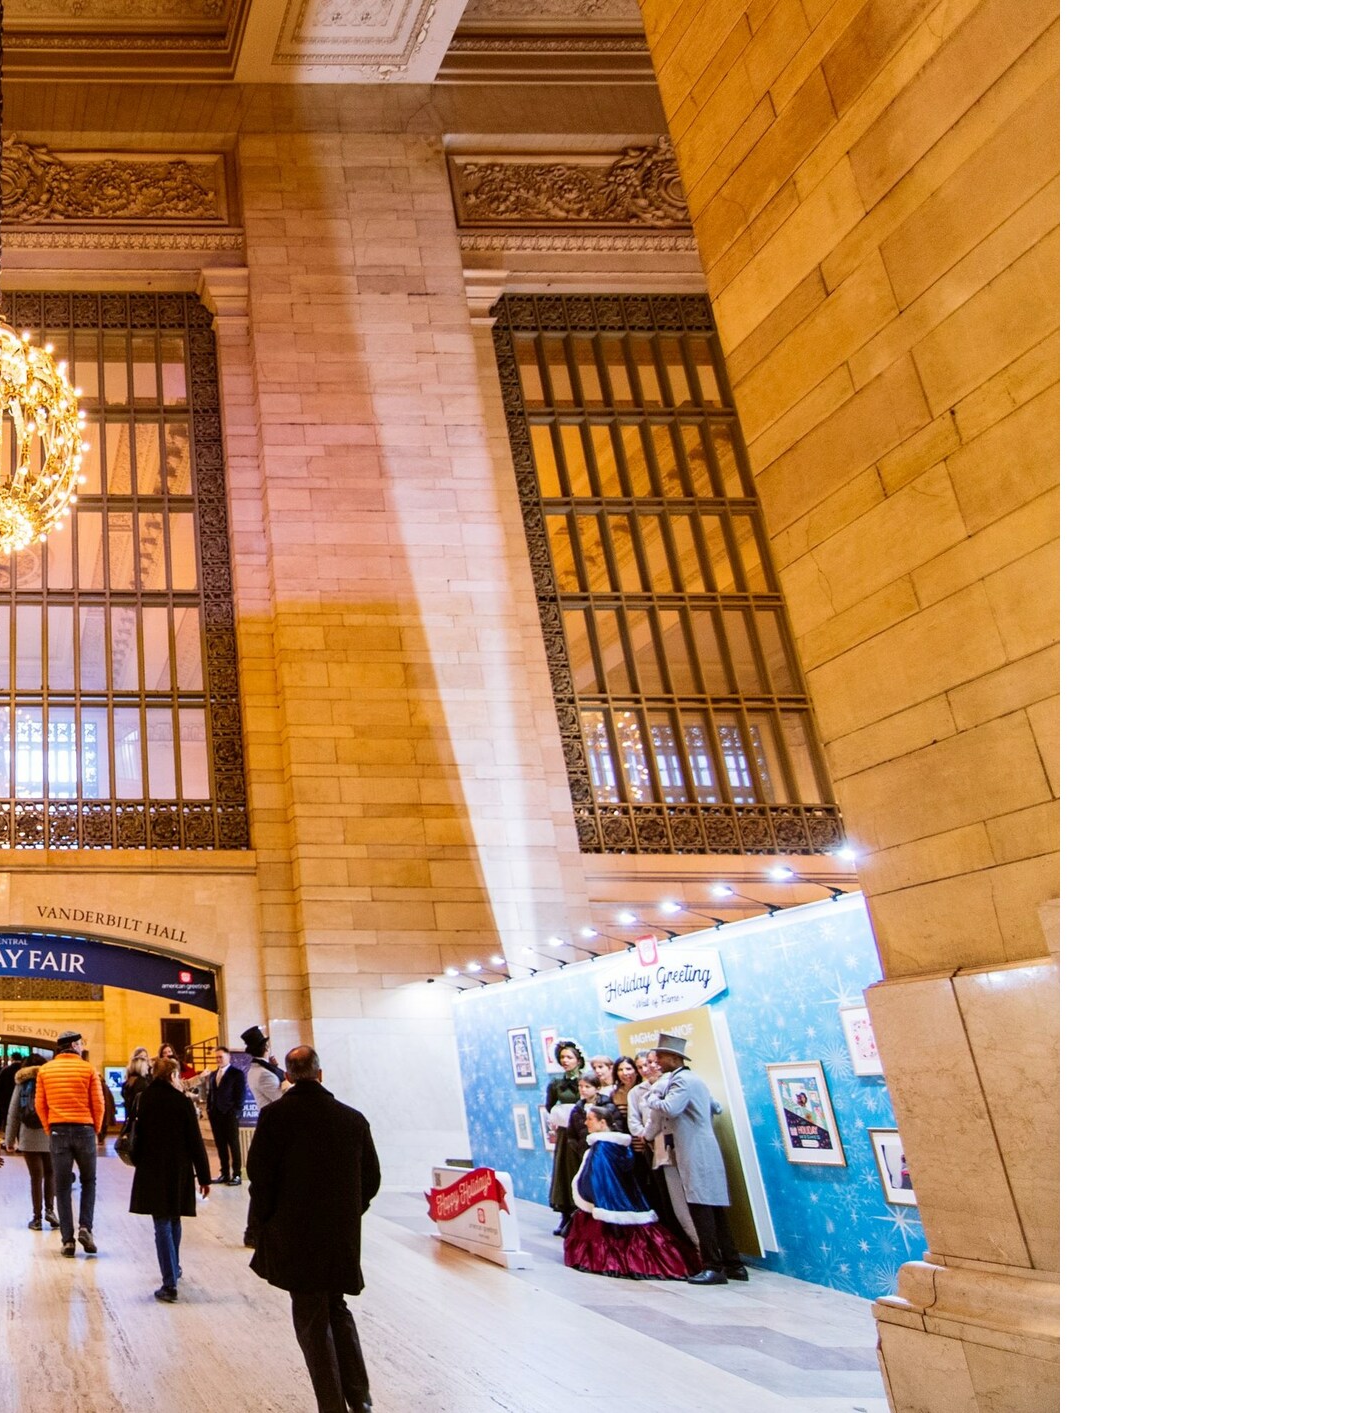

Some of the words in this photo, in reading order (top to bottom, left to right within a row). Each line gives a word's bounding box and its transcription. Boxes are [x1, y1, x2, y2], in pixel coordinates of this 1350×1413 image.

[36, 906, 143, 931] VANDERBILT
[146, 922, 188, 944] HALL
[29, 950, 86, 975] FAIR
[605, 973, 651, 1002] Holiday
[656, 964, 712, 989] Greeting
[6, 1023, 33, 1034] BUSES
[36, 1028, 58, 1039] AND
[436, 1191, 460, 1216] Happy
